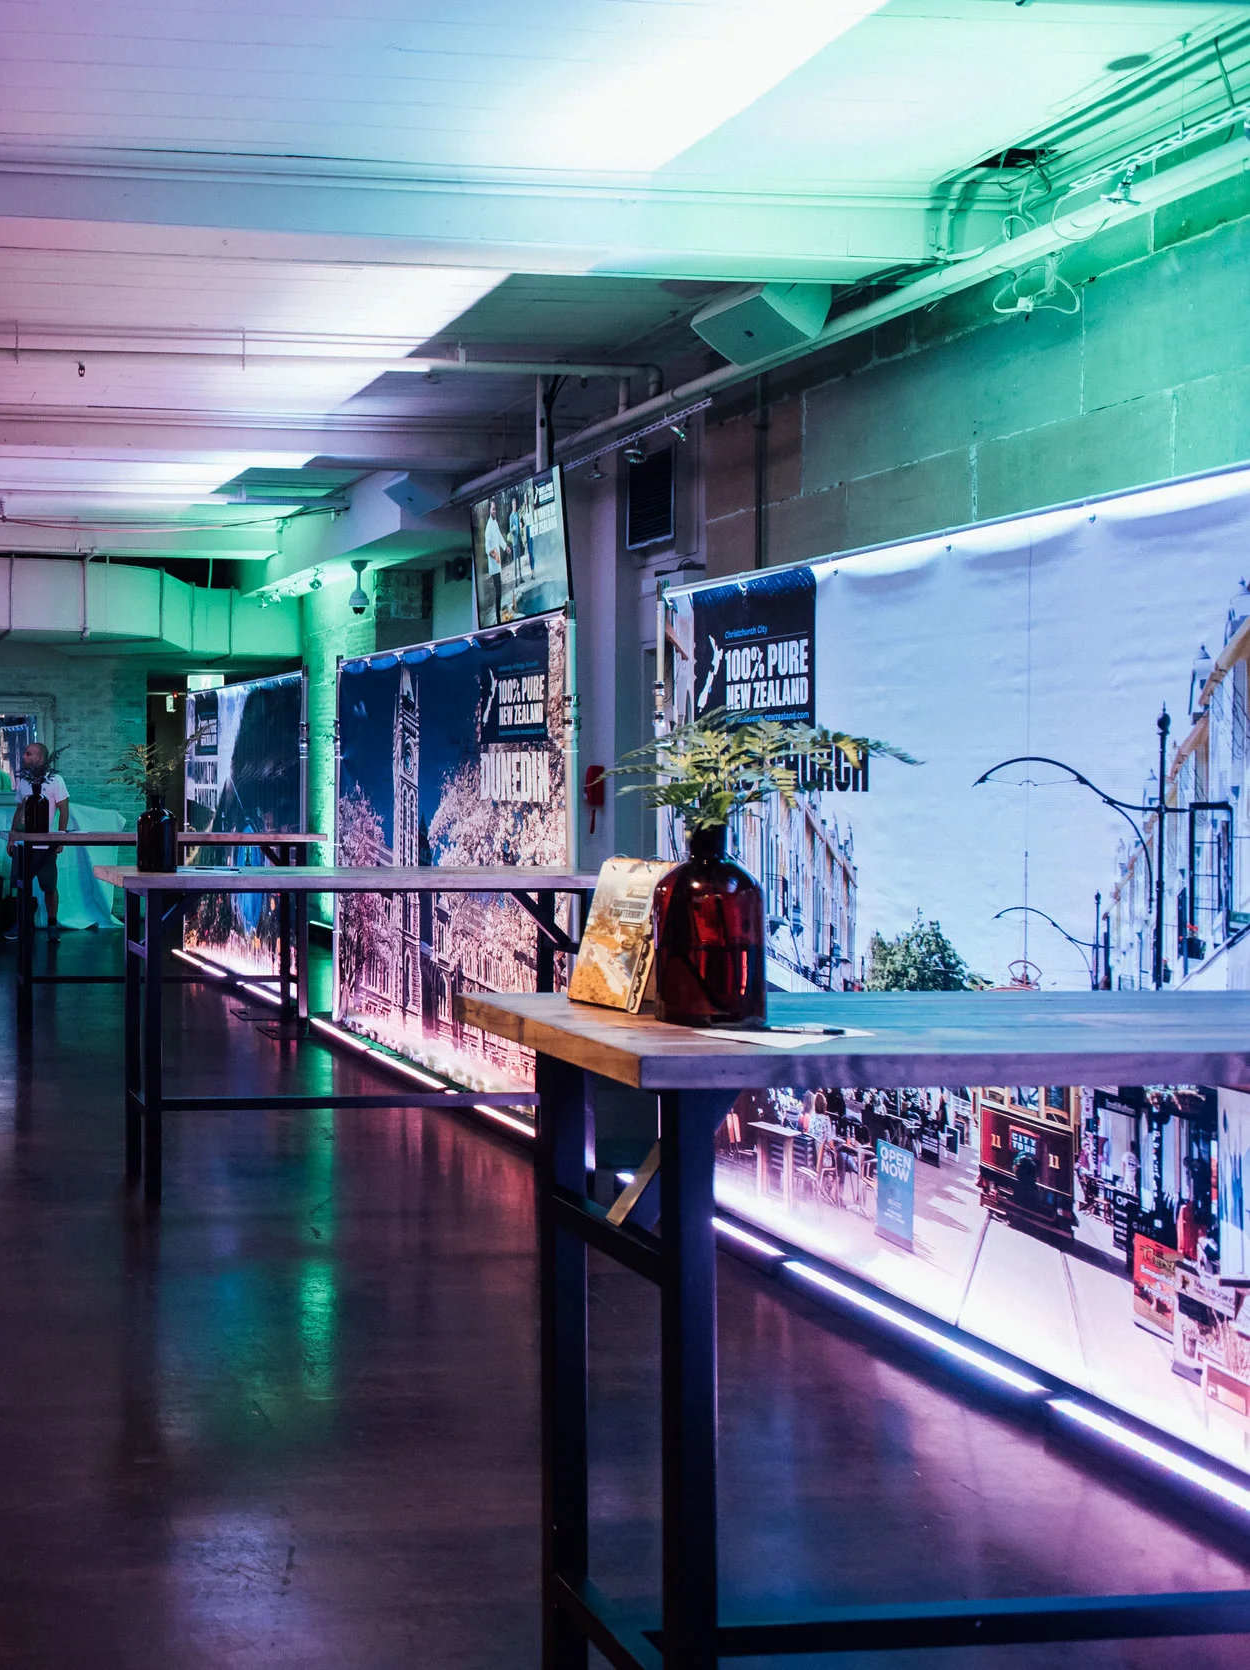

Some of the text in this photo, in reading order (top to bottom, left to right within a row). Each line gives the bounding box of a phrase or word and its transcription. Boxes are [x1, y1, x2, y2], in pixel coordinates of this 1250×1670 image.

[724, 624, 768, 640] Christchurch City
[724, 638, 809, 682] 100% PURE
[498, 674, 545, 704] 100% PURE
[726, 676, 809, 711] NEW ZEALAND
[498, 702, 544, 726] NEW ZEALAND
[479, 751, 550, 802] DUNEDIN
[991, 1132, 1037, 1149] 11 CITY
[1011, 1140, 1037, 1155] TOUR
[879, 1146, 912, 1170] OPEN
[1048, 1153, 1060, 1169] 11
[880, 1161, 910, 1183] NOW
